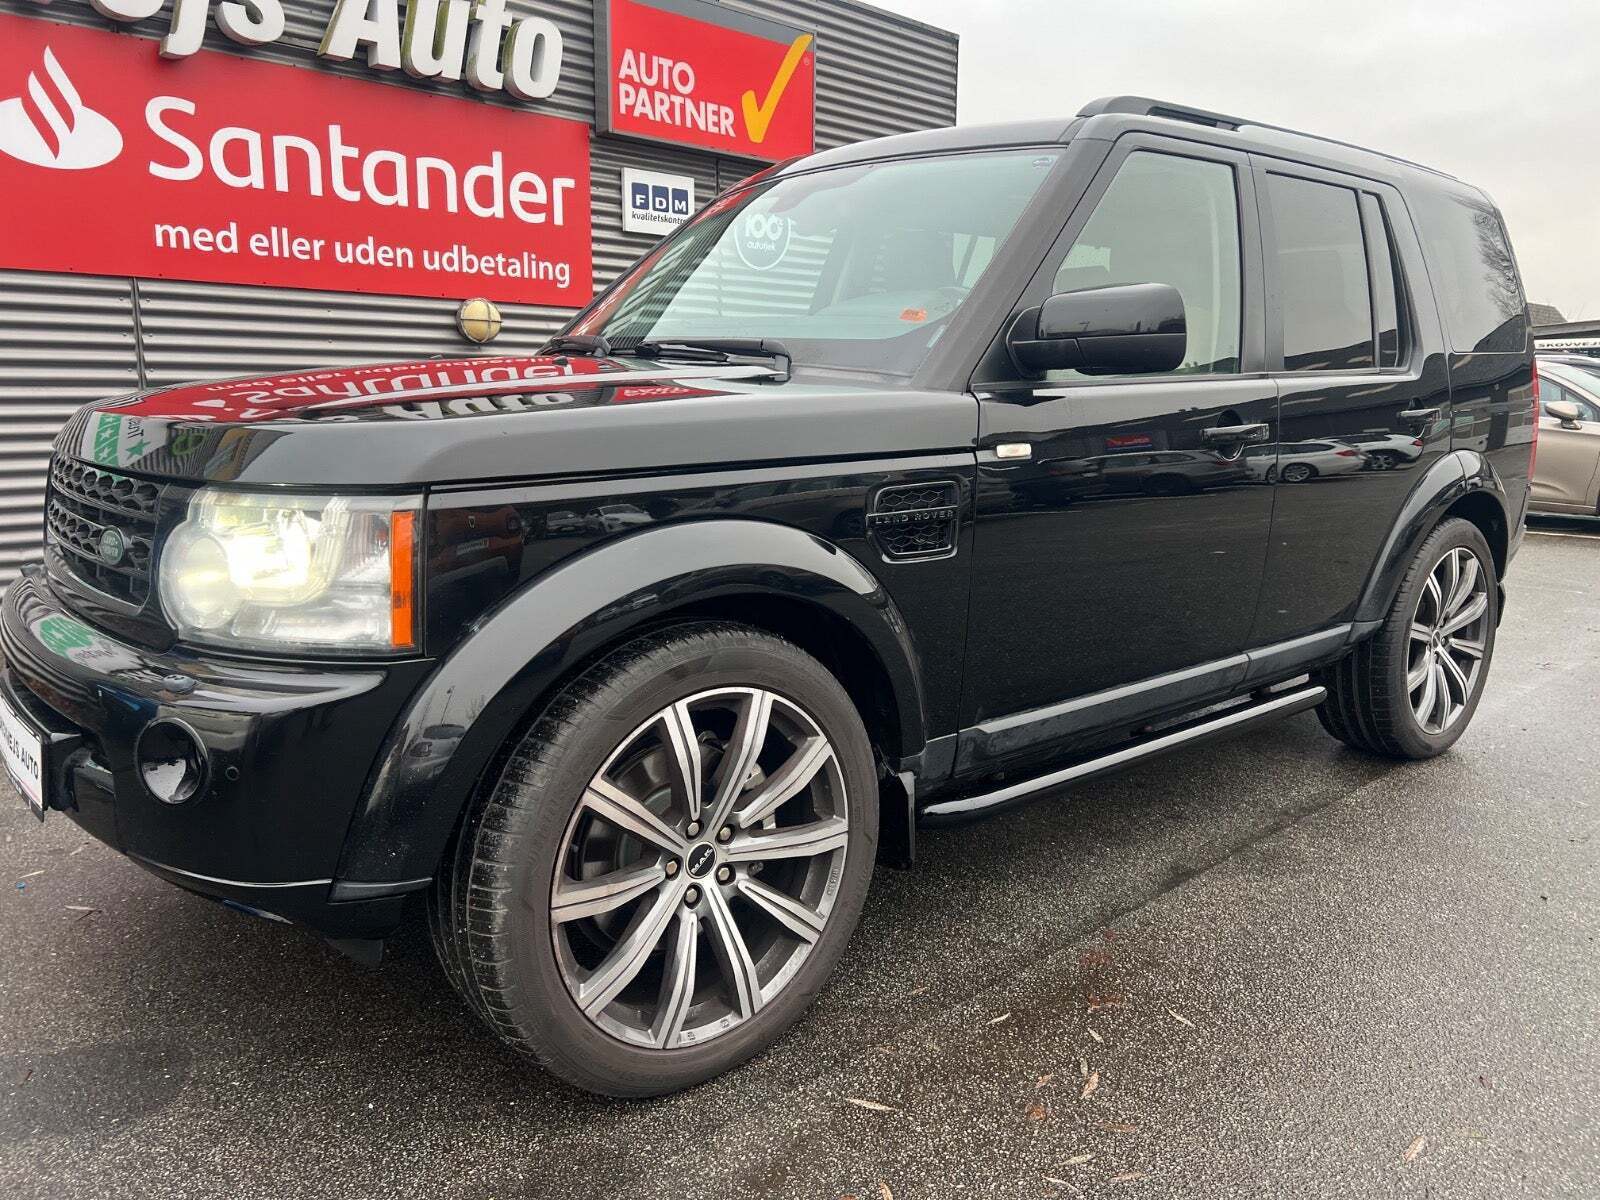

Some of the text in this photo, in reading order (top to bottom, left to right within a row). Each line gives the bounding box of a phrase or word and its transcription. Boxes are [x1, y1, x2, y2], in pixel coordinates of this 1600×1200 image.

[317, 0, 563, 100] Auto
[618, 48, 696, 95] AUTO
[618, 82, 737, 138] PARTNER
[145, 95, 576, 226] Santander
[635, 193, 687, 213] FDM
[154, 221, 571, 288] med eller uden udbetaling
[914, 510, 954, 521] ROVER
[21, 747, 39, 781] AUTO
